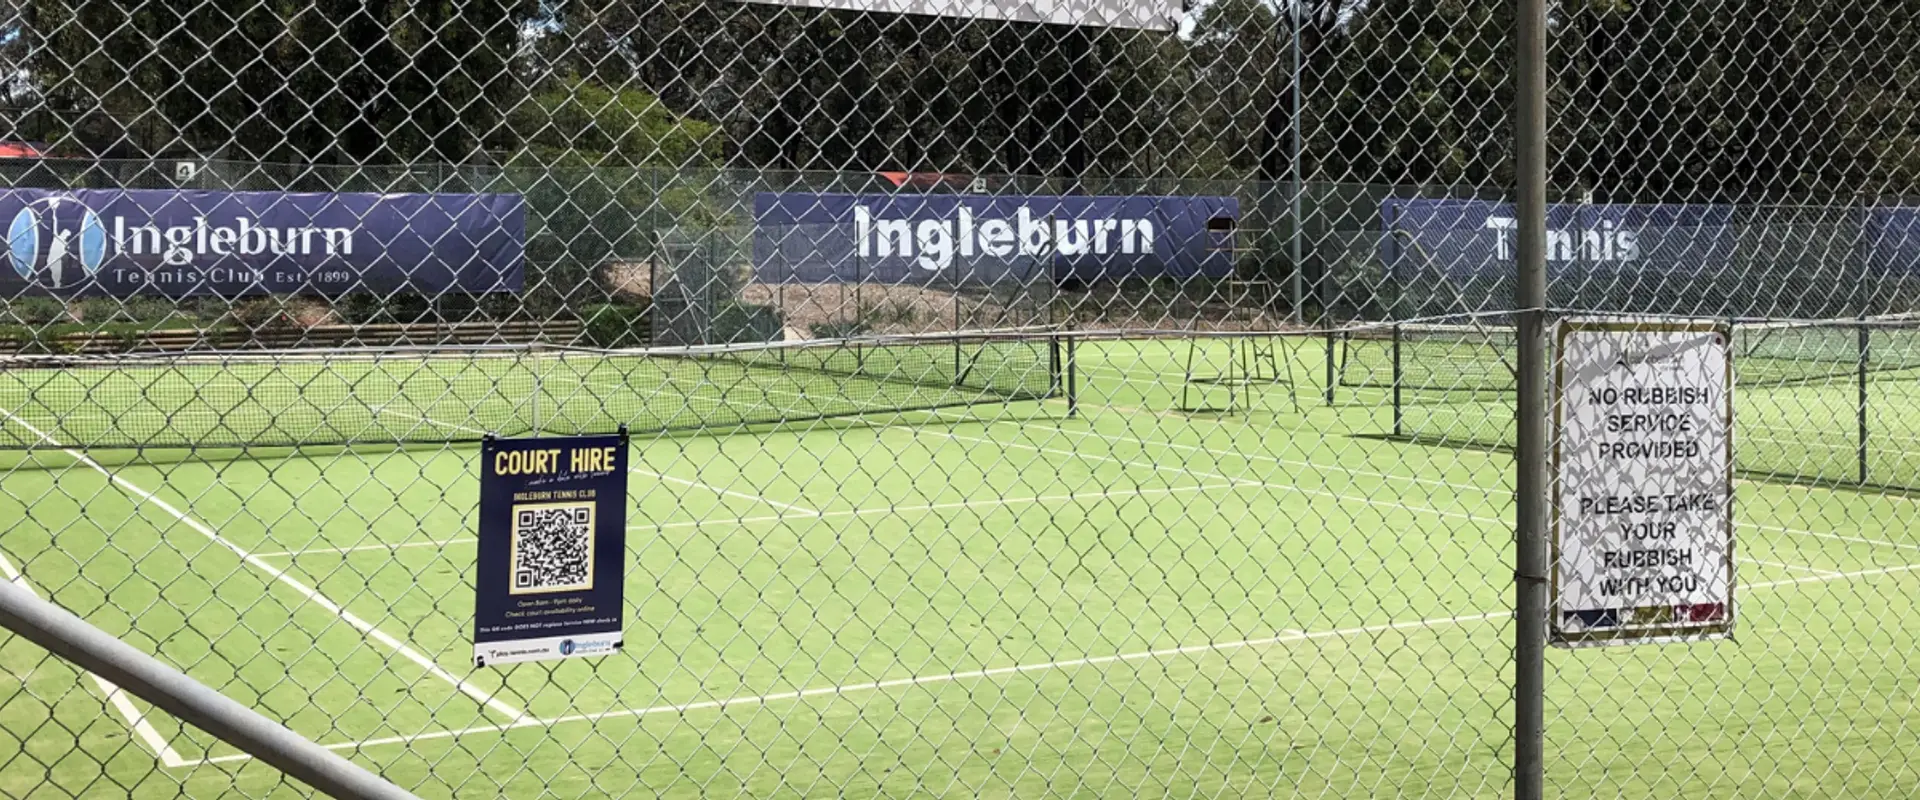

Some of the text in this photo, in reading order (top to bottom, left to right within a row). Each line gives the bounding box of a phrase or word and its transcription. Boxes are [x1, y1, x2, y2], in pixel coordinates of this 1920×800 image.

[114, 215, 353, 265] Ingleburn
[855, 206, 1154, 270] Ingleburn
[1486, 217, 1640, 261] Tnnis
[113, 268, 197, 283] Tennis
[210, 268, 264, 283] Club
[317, 271, 350, 283] 1899
[1589, 387, 1708, 405] NO RUBBISH
[1607, 414, 1691, 432] SERVICE
[1599, 441, 1698, 459] PROVIDED
[495, 446, 616, 476] COURT HIRE
[553, 489, 577, 499] TENNIS
[579, 489, 596, 498] CLUB
[1580, 494, 1715, 515] PLEASE TAKE
[1620, 522, 1676, 540] YOUR
[1604, 548, 1692, 568] RUBBISH
[1600, 575, 1697, 597] WITH YOU
[517, 600, 535, 609] Open
[505, 610, 526, 618] Check
